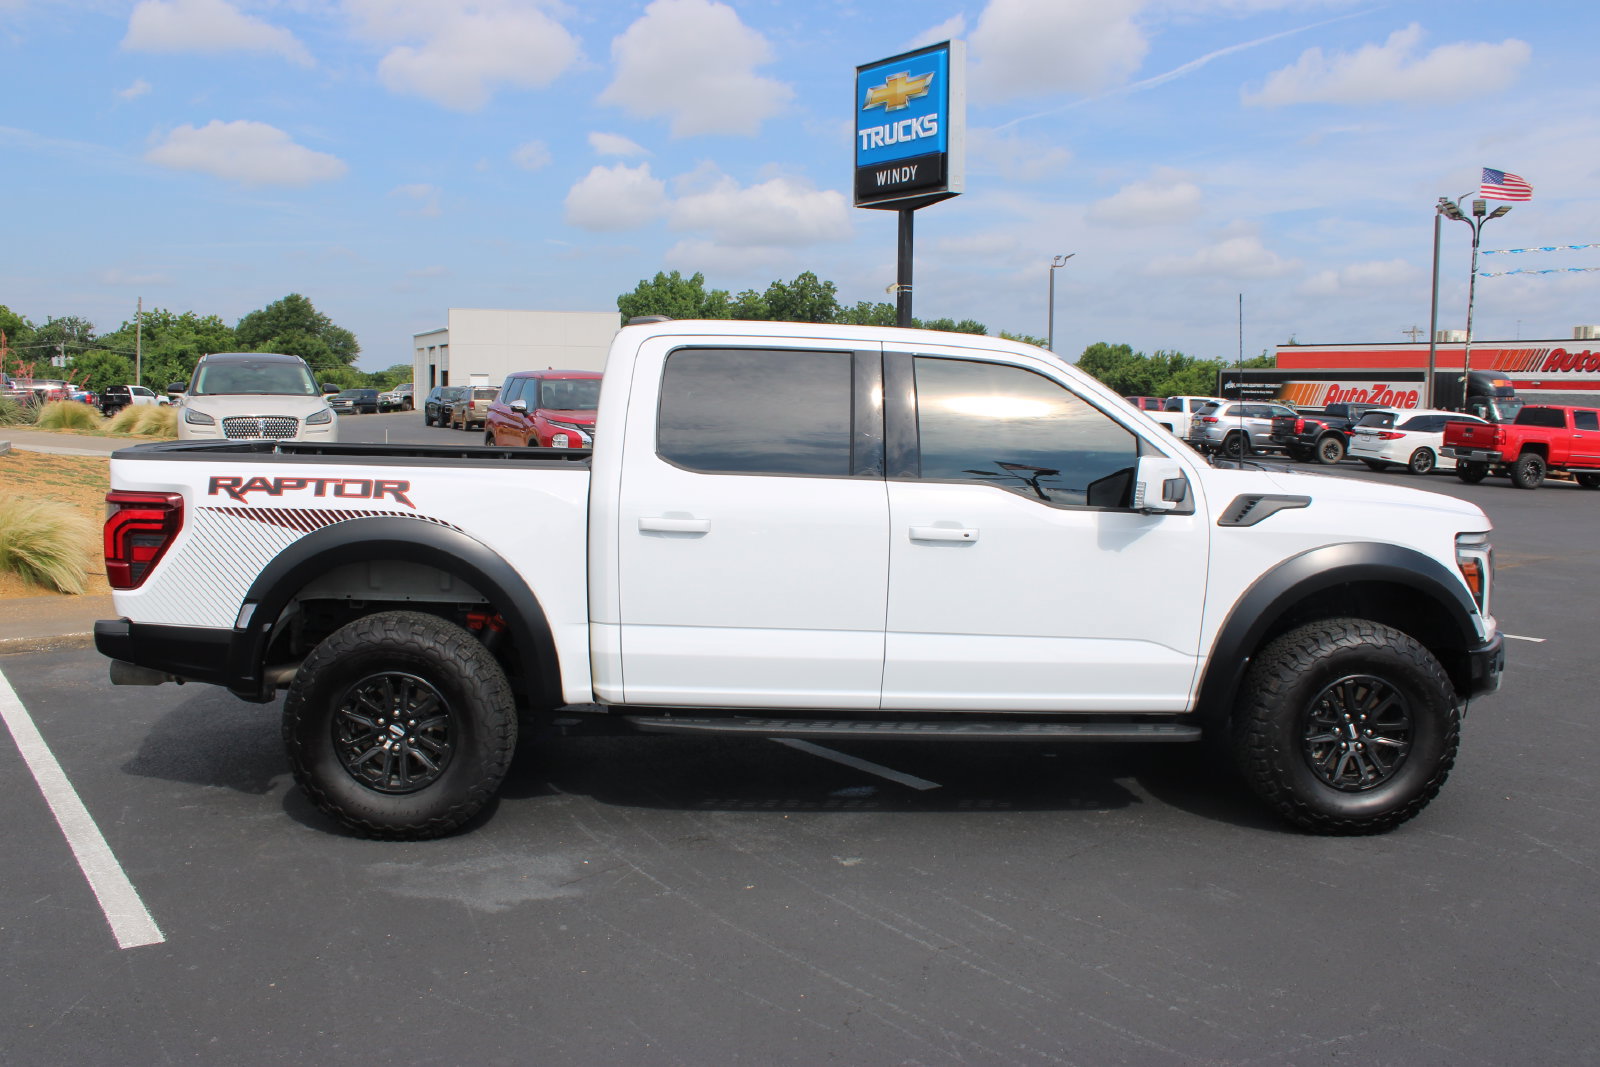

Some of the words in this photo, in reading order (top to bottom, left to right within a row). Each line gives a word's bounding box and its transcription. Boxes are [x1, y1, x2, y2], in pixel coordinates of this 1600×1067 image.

[859, 113, 938, 151] TRUCKS
[876, 165, 918, 186] WINDY
[1541, 348, 1600, 372] Auto
[1322, 383, 1420, 409] AutoZone
[207, 476, 417, 510] RAPTOR
